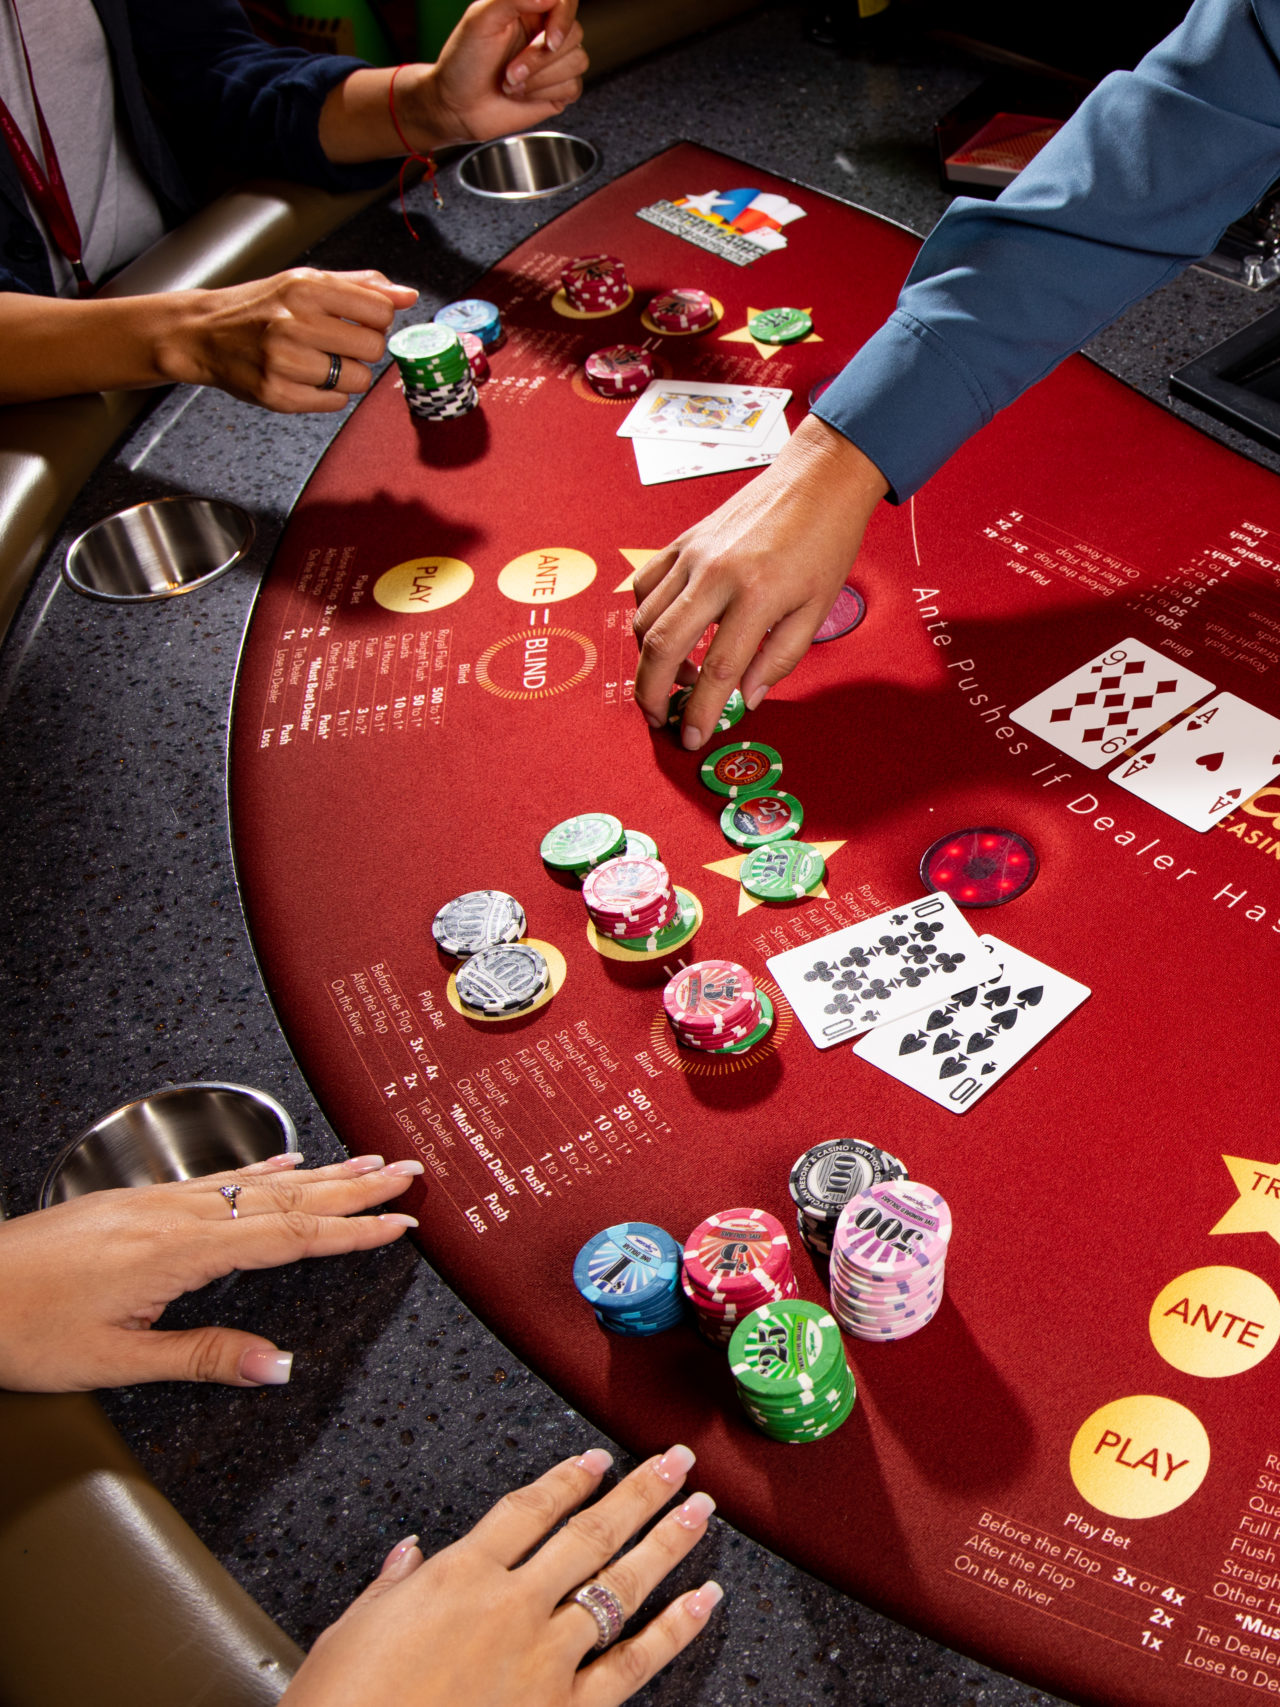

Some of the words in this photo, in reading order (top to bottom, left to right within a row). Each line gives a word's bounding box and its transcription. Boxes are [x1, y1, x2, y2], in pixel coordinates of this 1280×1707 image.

[1231, 545, 1273, 569] Dealer
[408, 565, 439, 604] PLAY
[530, 553, 560, 597] ANTE
[457, 663, 471, 684] Blind
[523, 637, 549, 690] BLIND
[1101, 649, 1128, 666] 9
[306, 681, 319, 702] Beat
[300, 700, 315, 732] Dealer
[1195, 707, 1220, 725] A
[912, 588, 952, 646] Ante
[947, 659, 1028, 755] Pushes
[1032, 763, 1072, 787] If
[1066, 793, 1197, 880] Dealer
[1099, 736, 1127, 754] 9
[1121, 759, 1148, 779] A
[1208, 796, 1233, 814] A
[911, 897, 945, 919] 10
[371, 963, 392, 994] Before
[387, 994, 401, 1011] the
[395, 1010, 413, 1033] Flop
[410, 1037, 424, 1053] 3x
[418, 1053, 431, 1064] or
[426, 1065, 439, 1080] 4x
[418, 990, 435, 1012] Play
[429, 1010, 447, 1030] Bet
[331, 979, 345, 996] On
[340, 995, 353, 1012] the
[347, 1011, 366, 1036] River
[384, 1082, 397, 1098] 1x
[350, 972, 368, 995] After
[362, 994, 377, 1012] the
[371, 1010, 388, 1034] Flop
[403, 1073, 418, 1090] 2x
[821, 1018, 857, 1041] 10
[949, 1076, 983, 1104] 10
[817, 1144, 850, 1158] CASINO
[855, 1207, 924, 1256] $500
[714, 1242, 750, 1272] $5
[1163, 1297, 1266, 1349] ANTE
[758, 1325, 789, 1375] $25
[1093, 1429, 1190, 1484] PLAY
[1063, 1513, 1100, 1540] Play
[1101, 1527, 1132, 1550] Bet
[978, 1512, 1032, 1545] Before
[1037, 1536, 1061, 1557] the
[1064, 1547, 1101, 1575] Flop
[1112, 1567, 1137, 1588] 3x
[1139, 1581, 1158, 1595] or
[1161, 1587, 1186, 1607] 4x
[965, 1534, 1007, 1560] After
[1008, 1551, 1035, 1573] the
[1038, 1562, 1075, 1591] Flop
[1149, 1608, 1175, 1629] 2x
[1213, 1582, 1264, 1608] Other
[954, 1555, 979, 1576] On
[982, 1566, 1009, 1589] the
[1012, 1578, 1054, 1607] River
[1140, 1631, 1164, 1651] 1x
[1196, 1625, 1220, 1647] Tie
